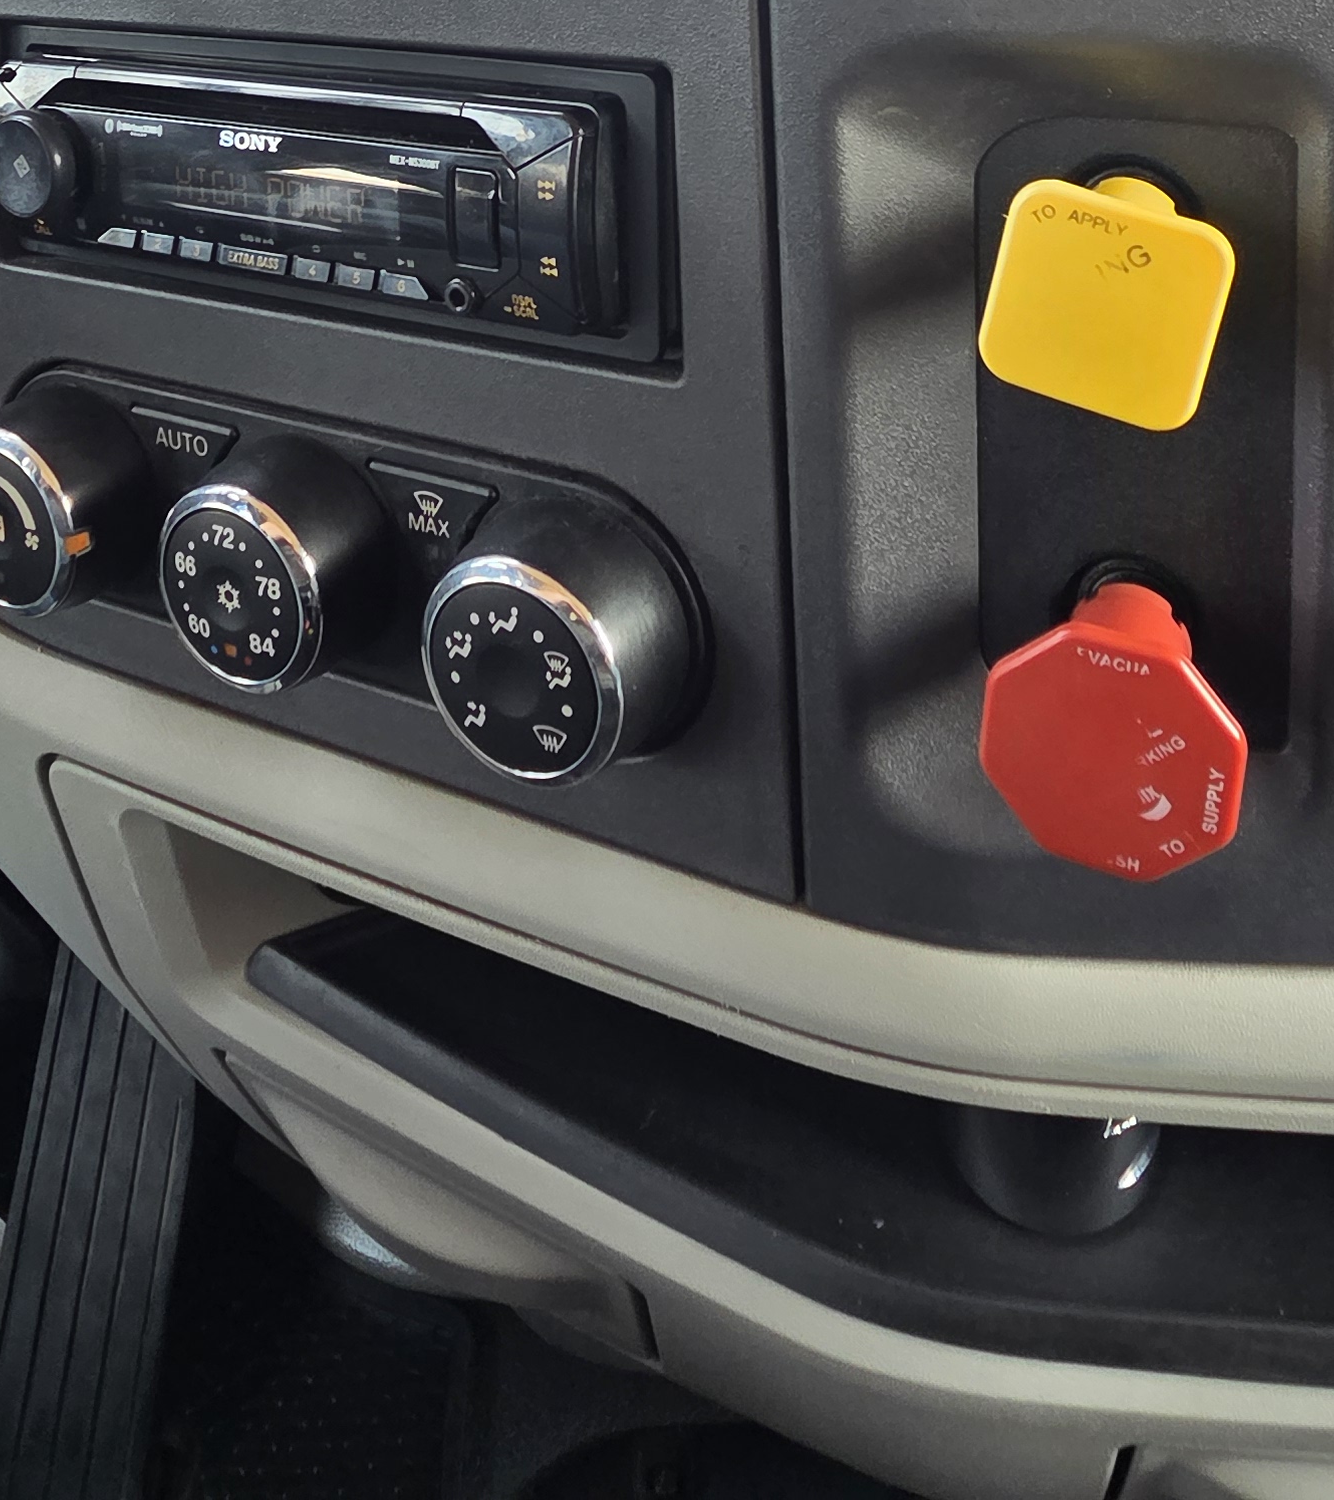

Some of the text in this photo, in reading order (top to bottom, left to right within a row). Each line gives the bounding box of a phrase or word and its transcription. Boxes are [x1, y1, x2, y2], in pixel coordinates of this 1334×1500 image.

[219, 129, 283, 153] SONY
[1030, 204, 1129, 236] TO APPLY
[227, 250, 280, 271] EXTRA BASS
[308, 264, 316, 277] 4
[352, 272, 361, 284] 5
[397, 280, 406, 293] 6
[155, 425, 210, 457] AUTO
[211, 524, 235, 550] 72
[408, 512, 451, 539] MAX
[174, 551, 197, 576] 66
[255, 575, 281, 600] 78
[188, 613, 210, 638] 60
[249, 633, 276, 657] 84
[1158, 838, 1185, 858] TO
[1201, 767, 1226, 836] SUPPLY
